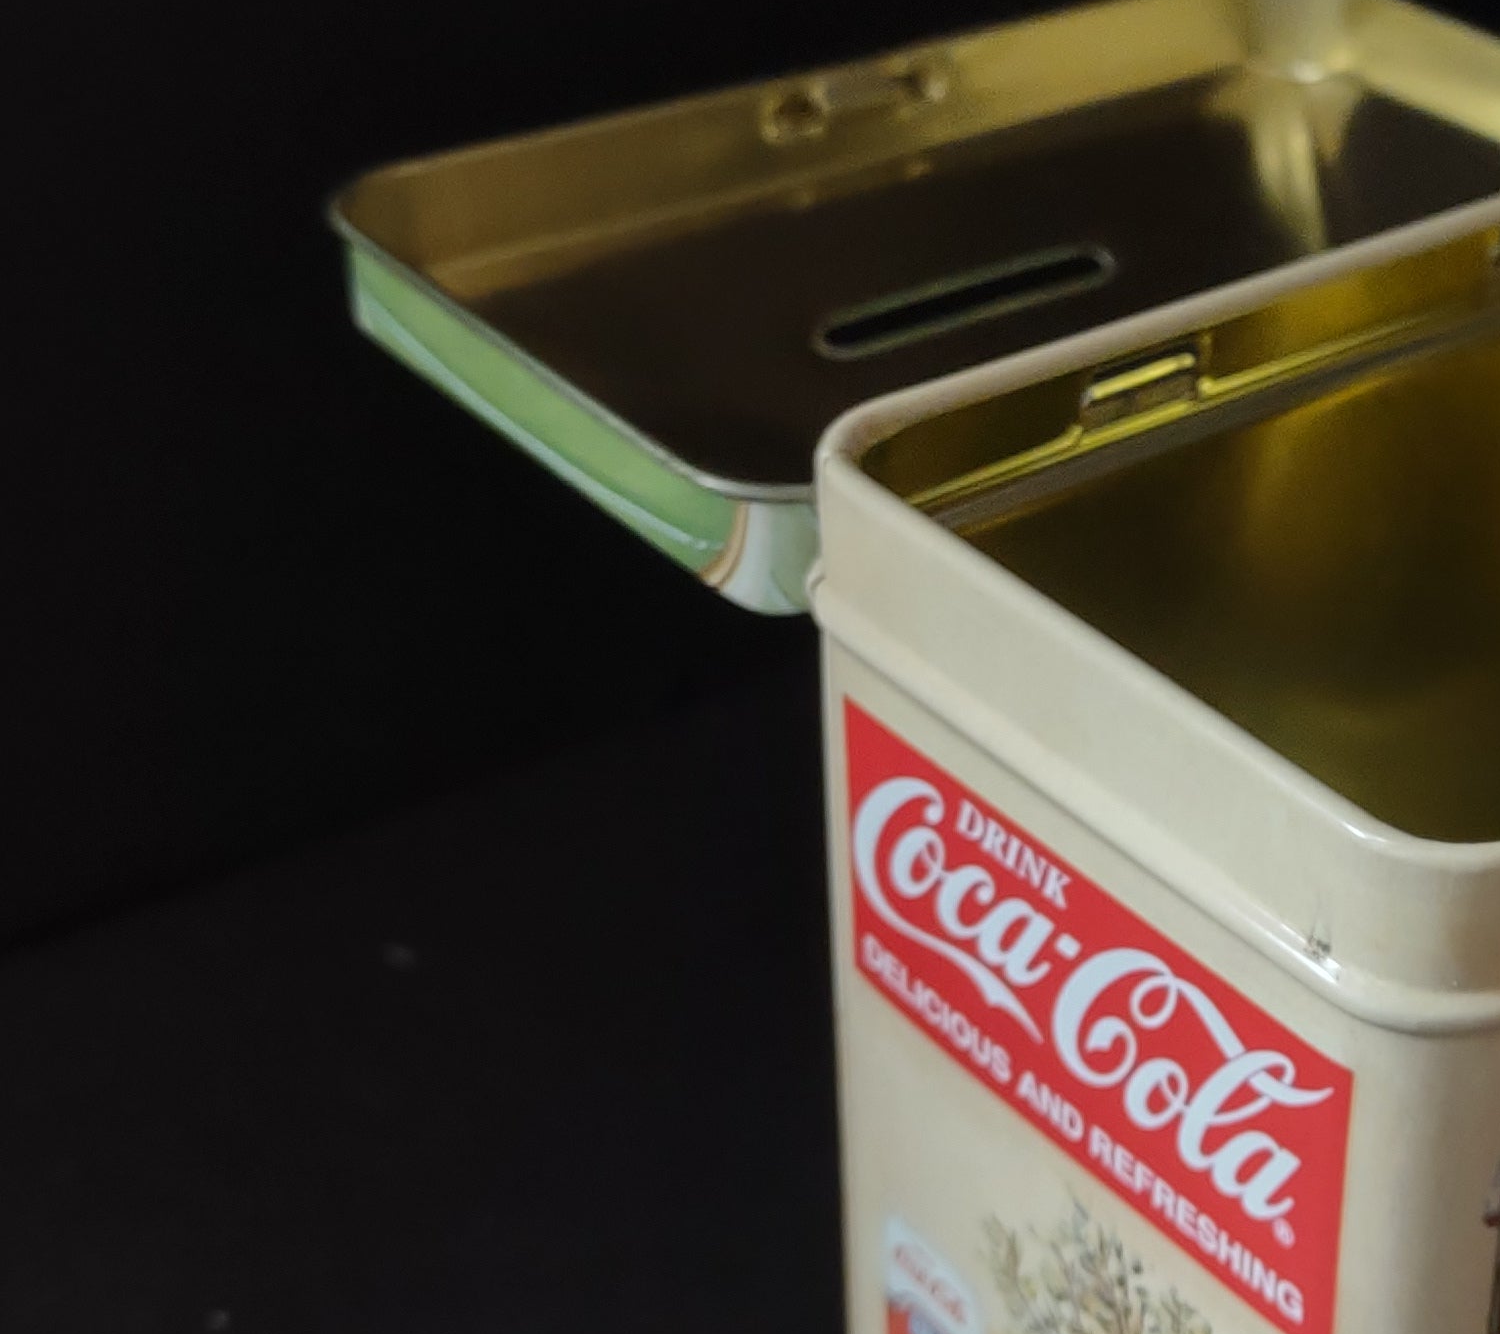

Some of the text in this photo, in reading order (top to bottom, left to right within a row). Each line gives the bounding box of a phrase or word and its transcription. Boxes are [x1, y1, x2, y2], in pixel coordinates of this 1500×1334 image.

[853, 776, 1335, 1220] Coca-Cola
[955, 798, 1073, 911] DRINK
[860, 931, 1012, 1081] DELICIOUS
[1016, 1070, 1084, 1143] AND
[1088, 1125, 1305, 1324] REFRESHING
